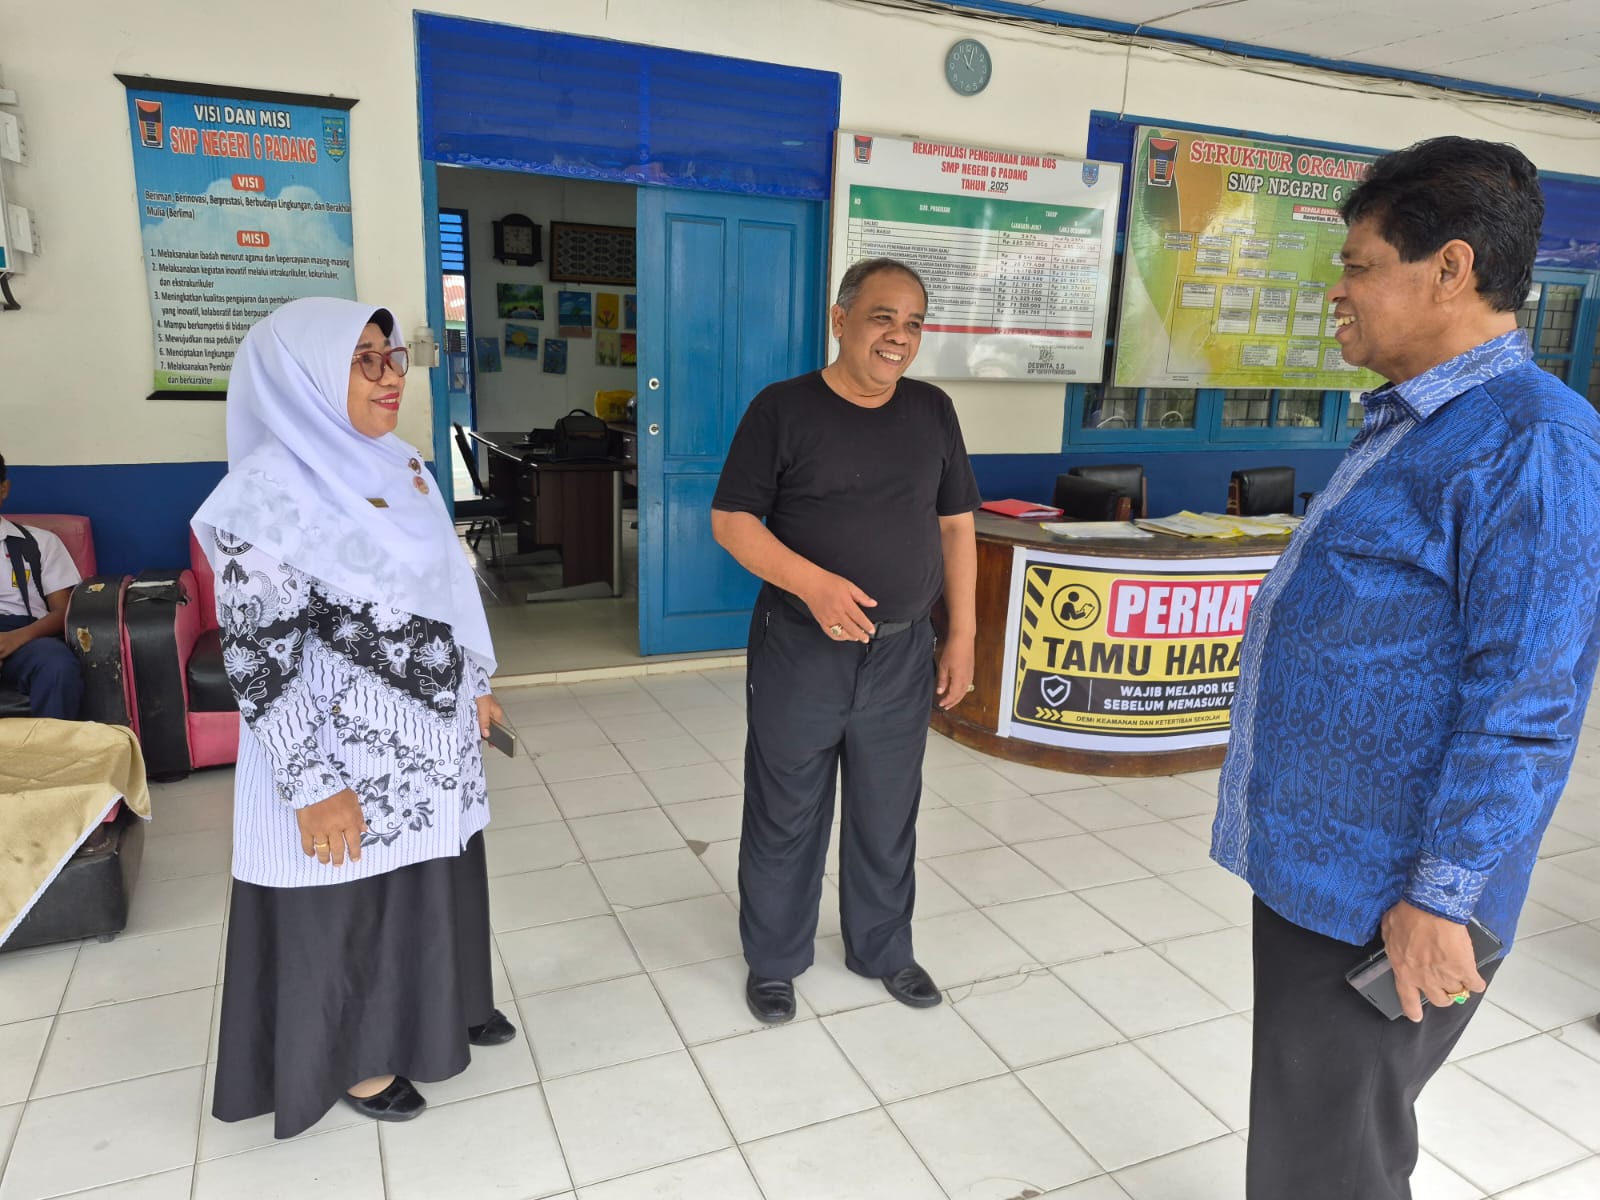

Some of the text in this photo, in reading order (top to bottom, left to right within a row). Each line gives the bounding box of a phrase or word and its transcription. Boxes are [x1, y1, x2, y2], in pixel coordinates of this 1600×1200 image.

[193, 104, 291, 129] VISI DAN MISI
[169, 126, 317, 164] SMP NEGERI 6 PADANG
[912, 141, 1057, 170] REKAPITULASI PENGGUNAAN DANA BOS
[1190, 140, 1293, 172] STRUKTUR
[941, 161, 1028, 181] SMP NEGERI 6 PADANG
[237, 176, 259, 189] VISI
[961, 178, 986, 191] TAHUN
[990, 181, 1009, 191] 2025
[1227, 172, 1264, 193] SMP
[1267, 177, 1328, 201] NEGERI
[1331, 184, 1342, 202] 6
[245, 197, 277, 210] Berbudaya
[314, 201, 325, 211] dan
[242, 234, 265, 245] MISI
[157, 249, 199, 259] Melaksanakan
[200, 250, 219, 260] ibadah
[220, 252, 244, 261] menurut
[245, 253, 263, 263] agama
[265, 253, 275, 263] dan
[276, 254, 310, 265] kepercayaan
[159, 263, 200, 274] Melaksanakan
[201, 266, 224, 275] kegiatan
[226, 266, 246, 275] inovatif
[248, 267, 268, 276] melalui
[160, 277, 214, 288] dan ekstrakurikuler
[161, 292, 202, 303] Meningkatkan
[203, 293, 225, 302] kualitas
[226, 295, 257, 304] pengajaran
[161, 307, 176, 316] yang
[201, 307, 231, 316] kolaboratif
[232, 308, 243, 316] dan
[163, 320, 186, 330] Mampu
[187, 320, 224, 331] berkompetisi
[225, 321, 231, 330] di
[165, 334, 203, 345] Mewujudkan
[203, 336, 215, 344] rasa
[216, 336, 234, 346] peduli
[166, 348, 203, 358] Menciptakan
[204, 349, 234, 359] lingkungan
[167, 362, 208, 371] Melaksanakan
[167, 376, 213, 385] dan berkarakter
[1042, 636, 1152, 676] TAMU
[1120, 681, 1235, 697] WAJIB MELAPOR KE
[1103, 699, 1164, 711] SEBELUM
[1167, 696, 1226, 711] MEMASUKI
[1076, 715, 1094, 723] DEMI
[1096, 717, 1138, 726] KEAMANAN
[1155, 717, 1192, 726] KETERTIBAN
[1193, 714, 1220, 723] SEKOLAH
